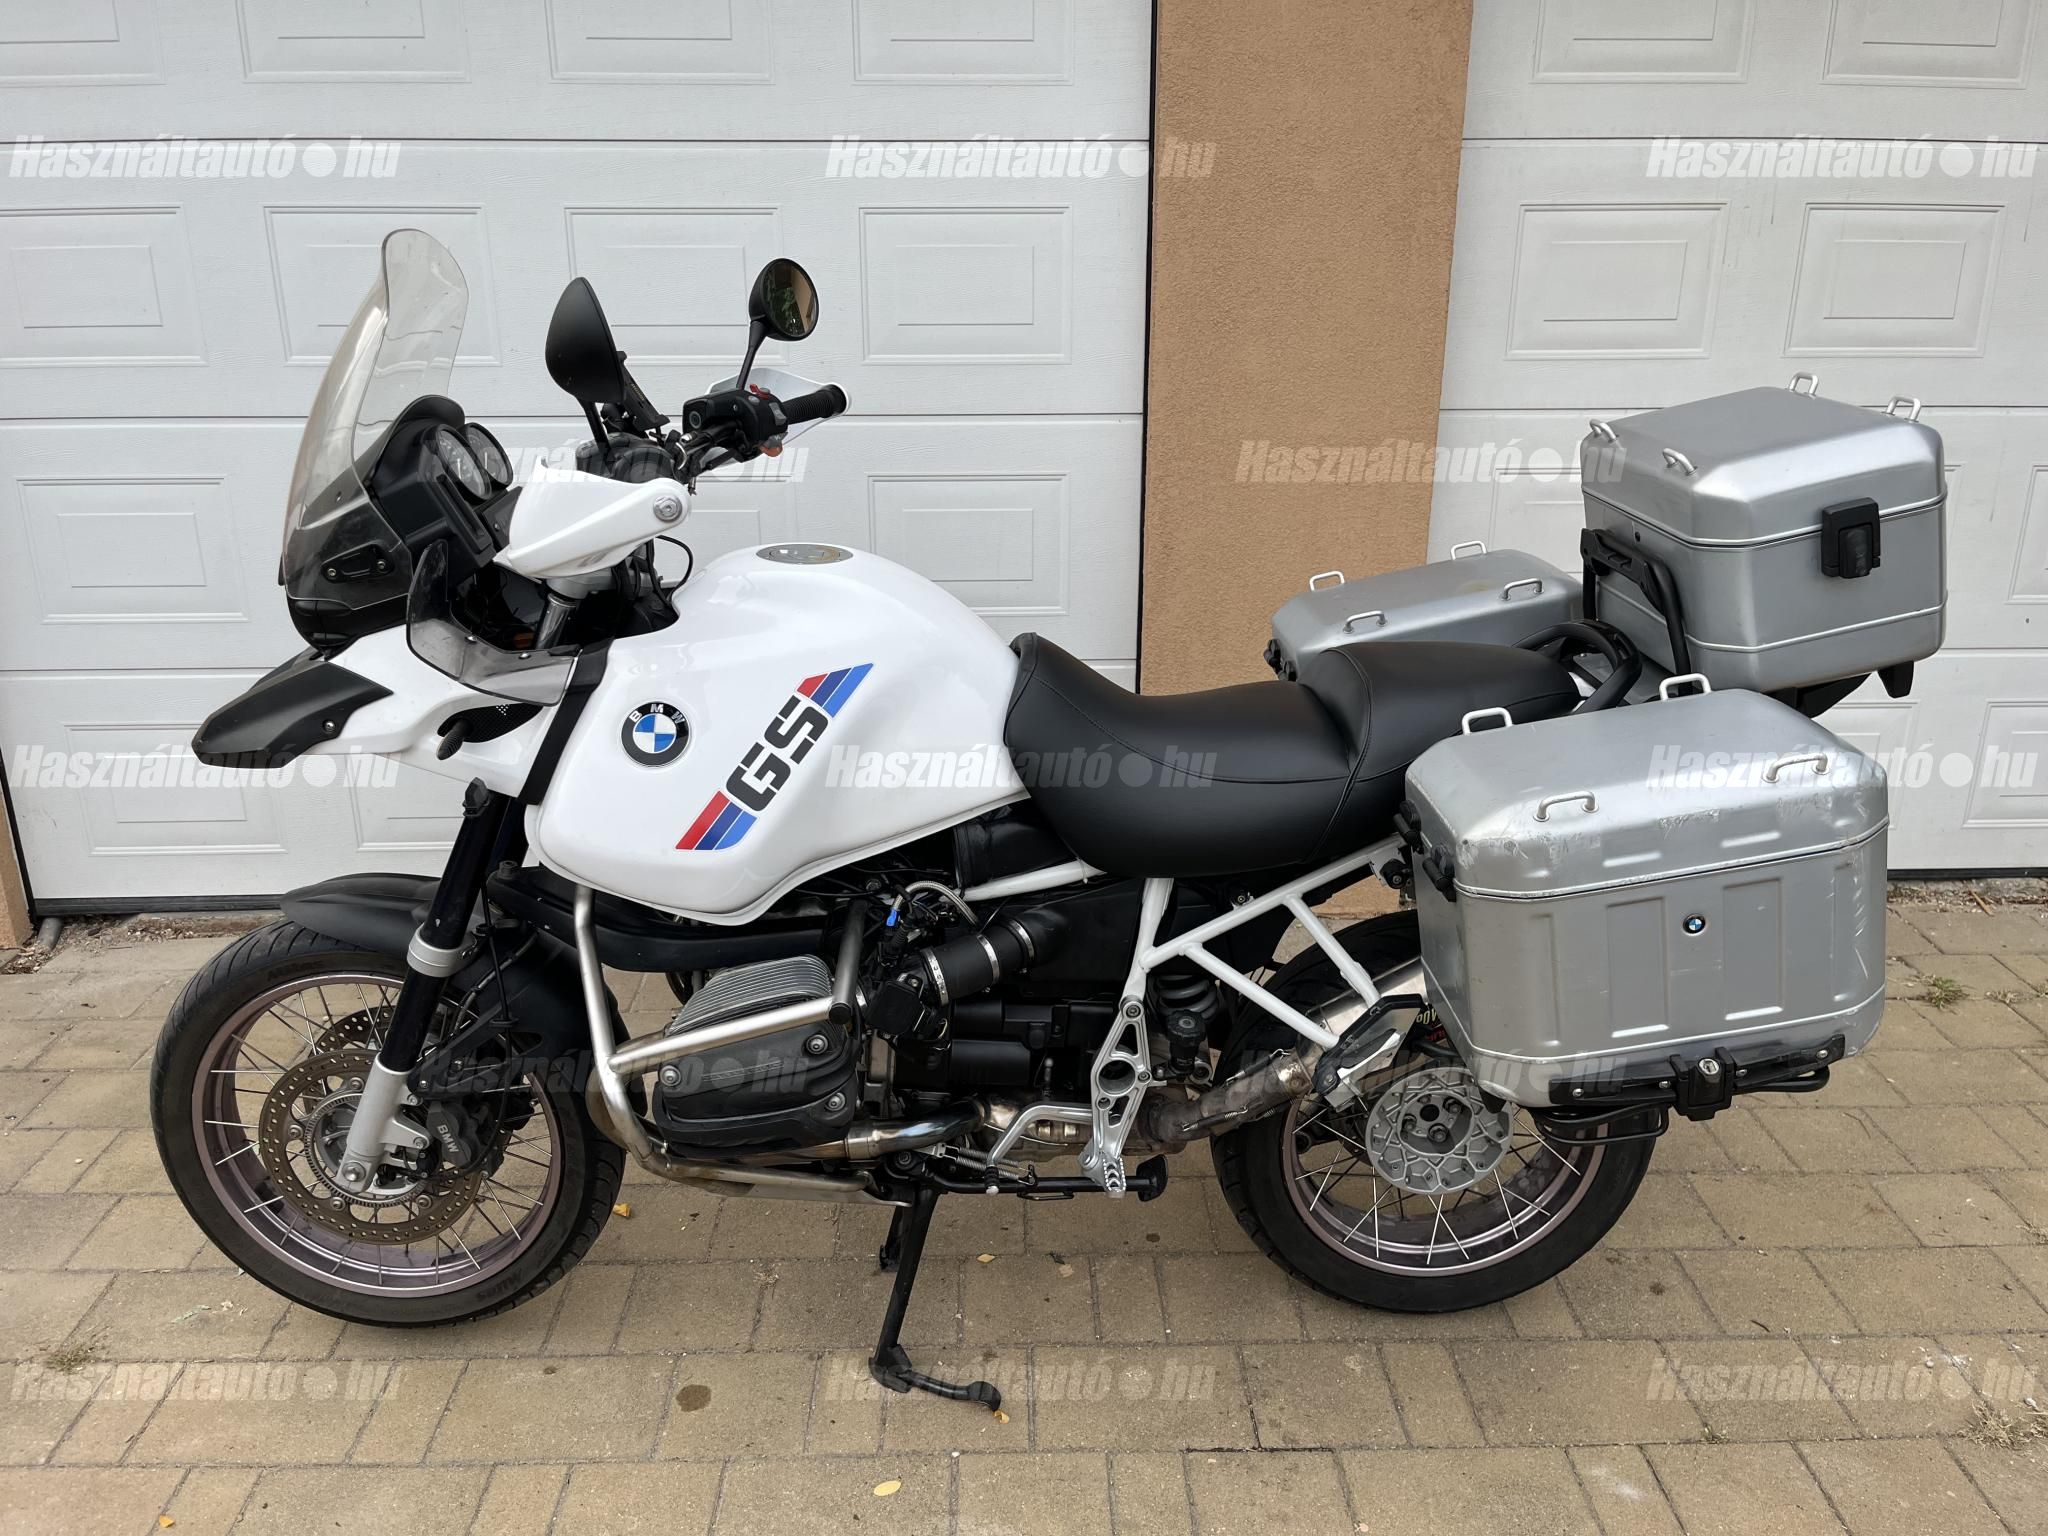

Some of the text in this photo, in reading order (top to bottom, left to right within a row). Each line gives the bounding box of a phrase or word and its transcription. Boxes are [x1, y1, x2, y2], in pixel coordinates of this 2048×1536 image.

[628, 703, 686, 724] BMW
[726, 695, 829, 811] GS
[437, 1124, 460, 1153] BMW
